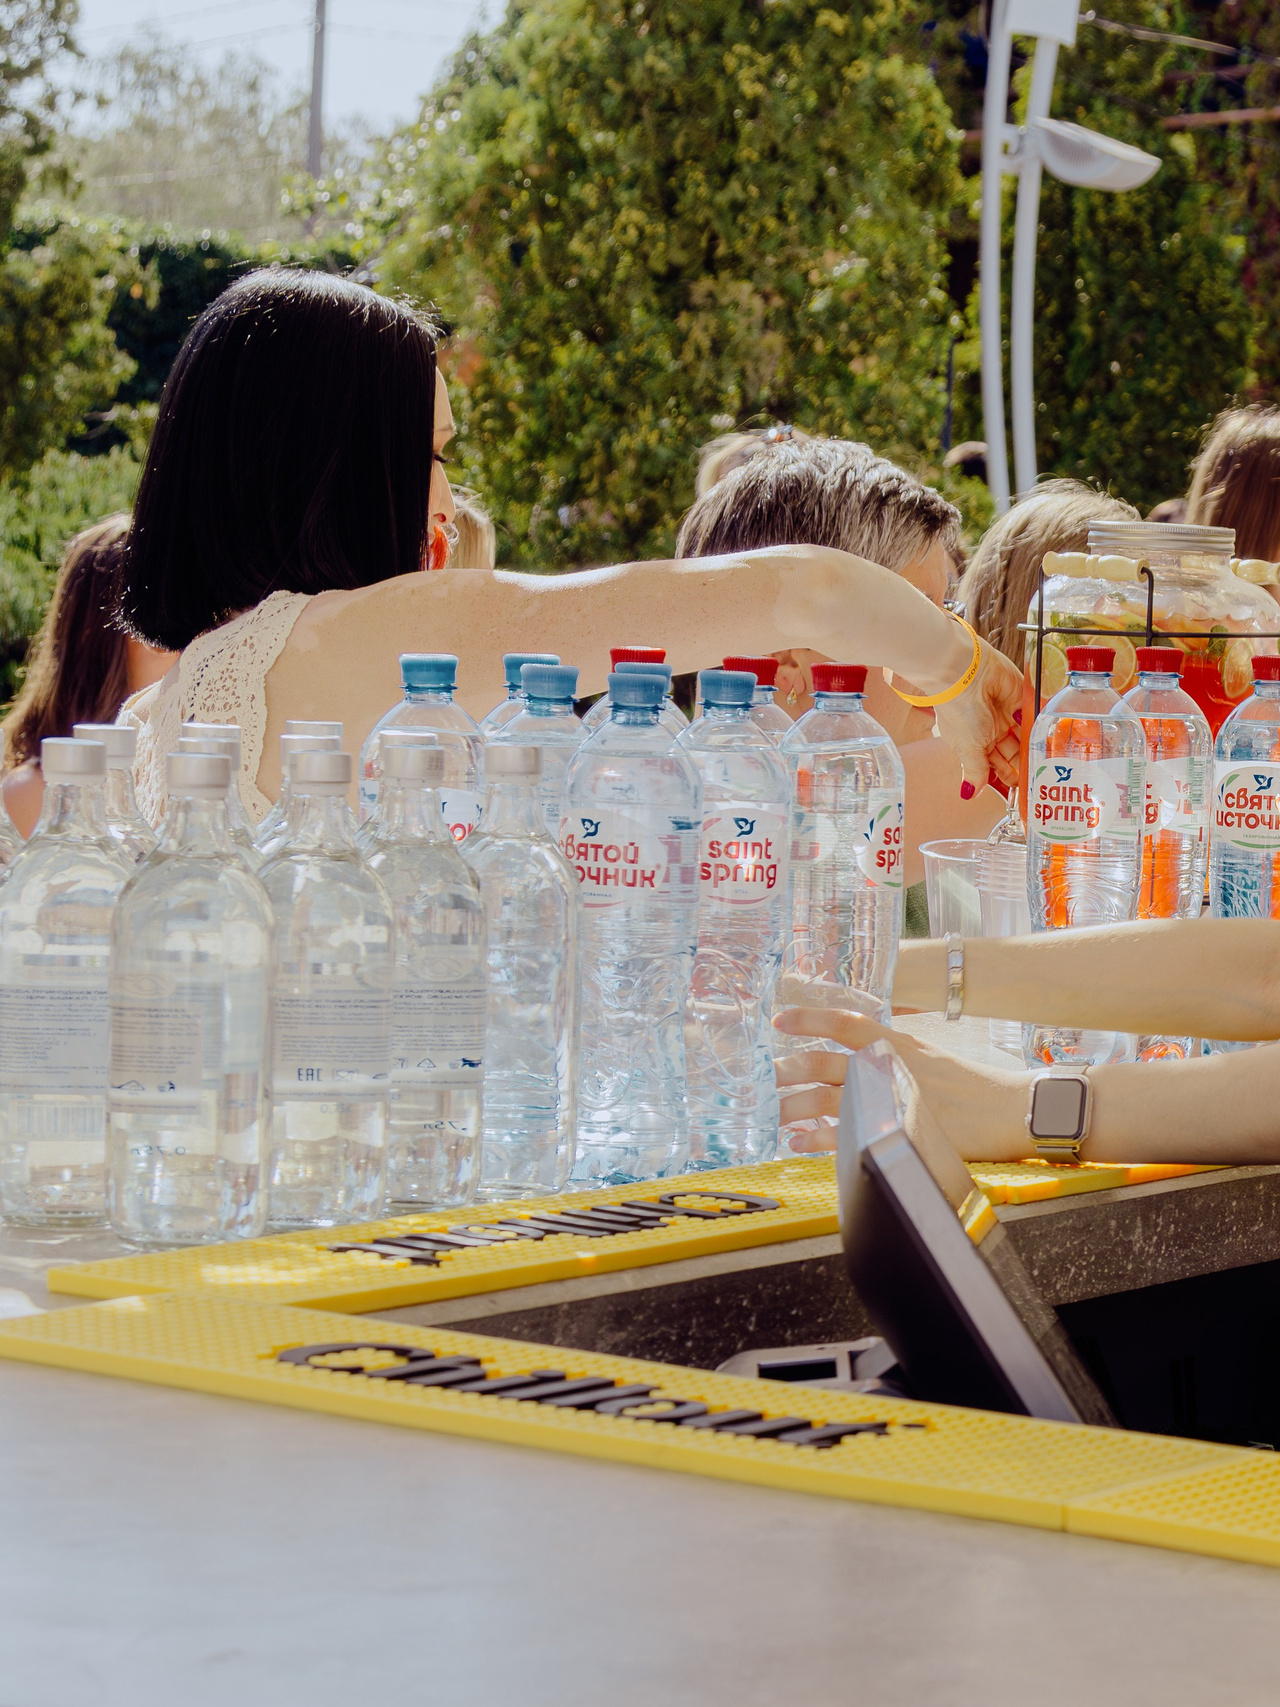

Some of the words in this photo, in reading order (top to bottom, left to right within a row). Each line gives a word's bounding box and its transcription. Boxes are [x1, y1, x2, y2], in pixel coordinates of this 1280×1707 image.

[1039, 784, 1093, 803] saint
[1034, 802, 1100, 829] spring
[708, 837, 772, 860] saint
[876, 849, 904, 874] spr
[574, 863, 656, 889] очник
[700, 862, 778, 890] spring
